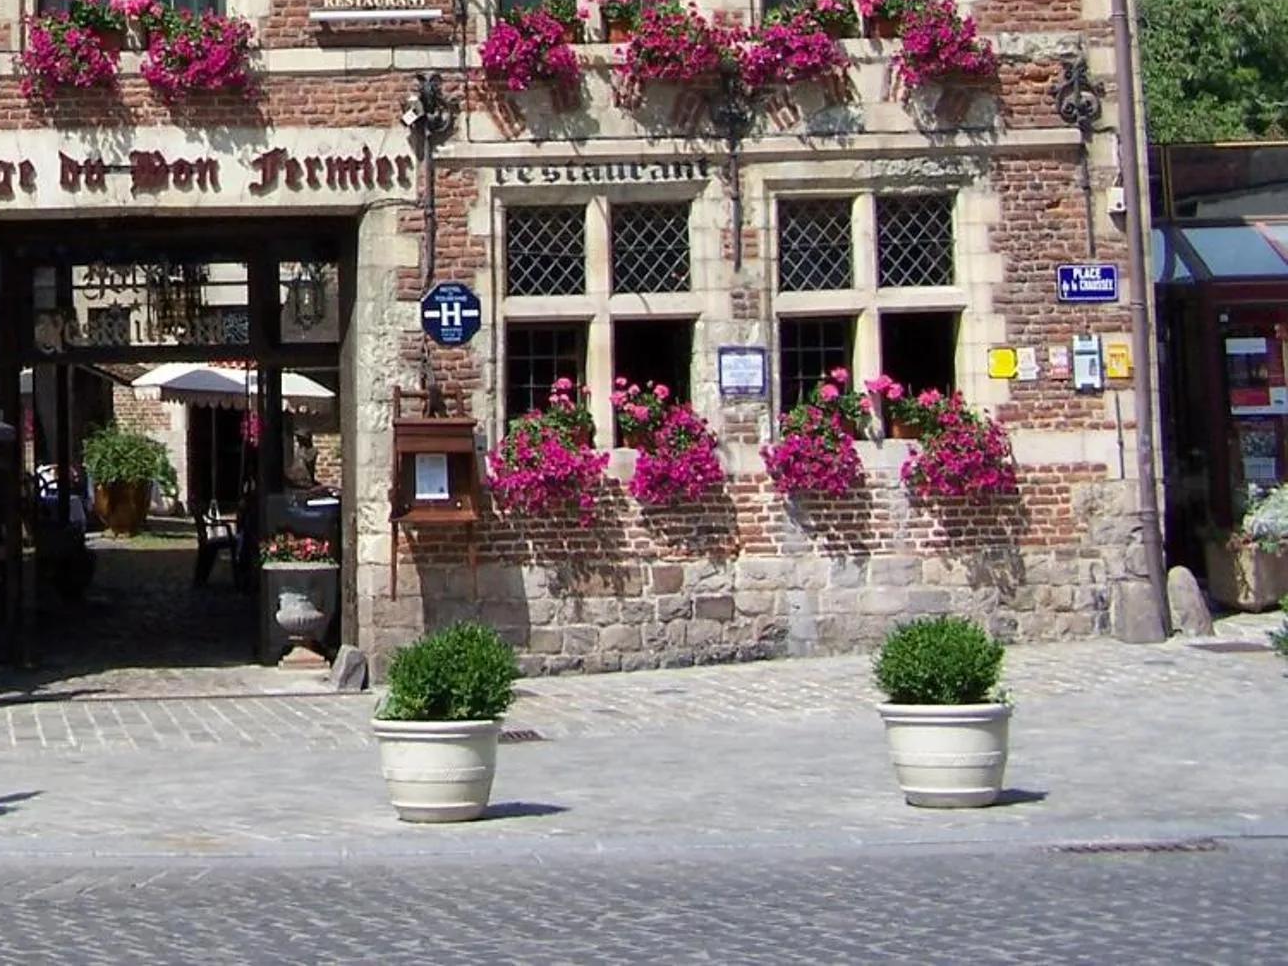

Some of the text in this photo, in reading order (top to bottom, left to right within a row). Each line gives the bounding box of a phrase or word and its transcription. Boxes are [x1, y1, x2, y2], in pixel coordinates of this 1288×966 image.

[128, 149, 223, 199] Bon
[248, 146, 414, 198] Fermier
[496, 157, 710, 184] restaurant
[1073, 267, 1101, 279] PLACE
[440, 302, 462, 326] H
